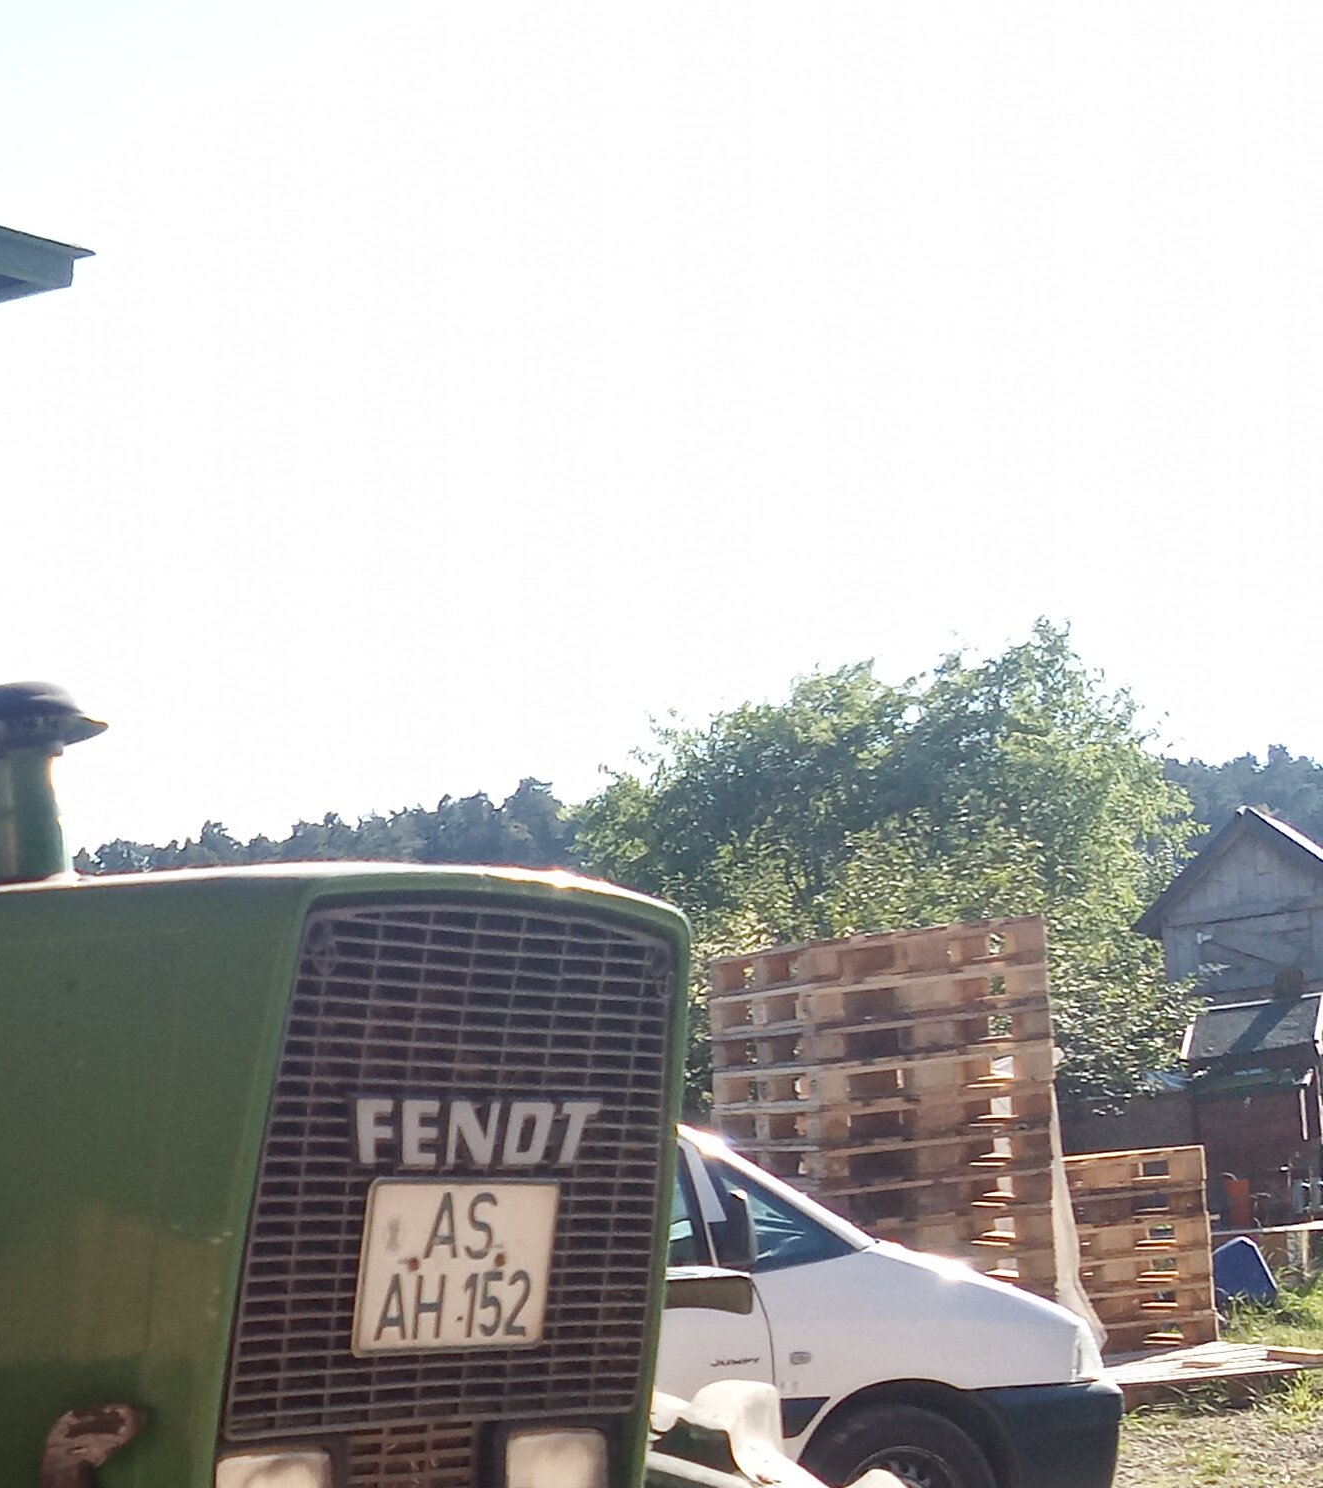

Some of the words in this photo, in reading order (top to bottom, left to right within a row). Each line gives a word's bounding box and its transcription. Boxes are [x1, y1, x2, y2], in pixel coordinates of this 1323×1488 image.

[355, 1098, 604, 1167] FENDT
[423, 1191, 499, 1260] AS
[372, 1273, 448, 1342] AH
[463, 1269, 532, 1339] 152
